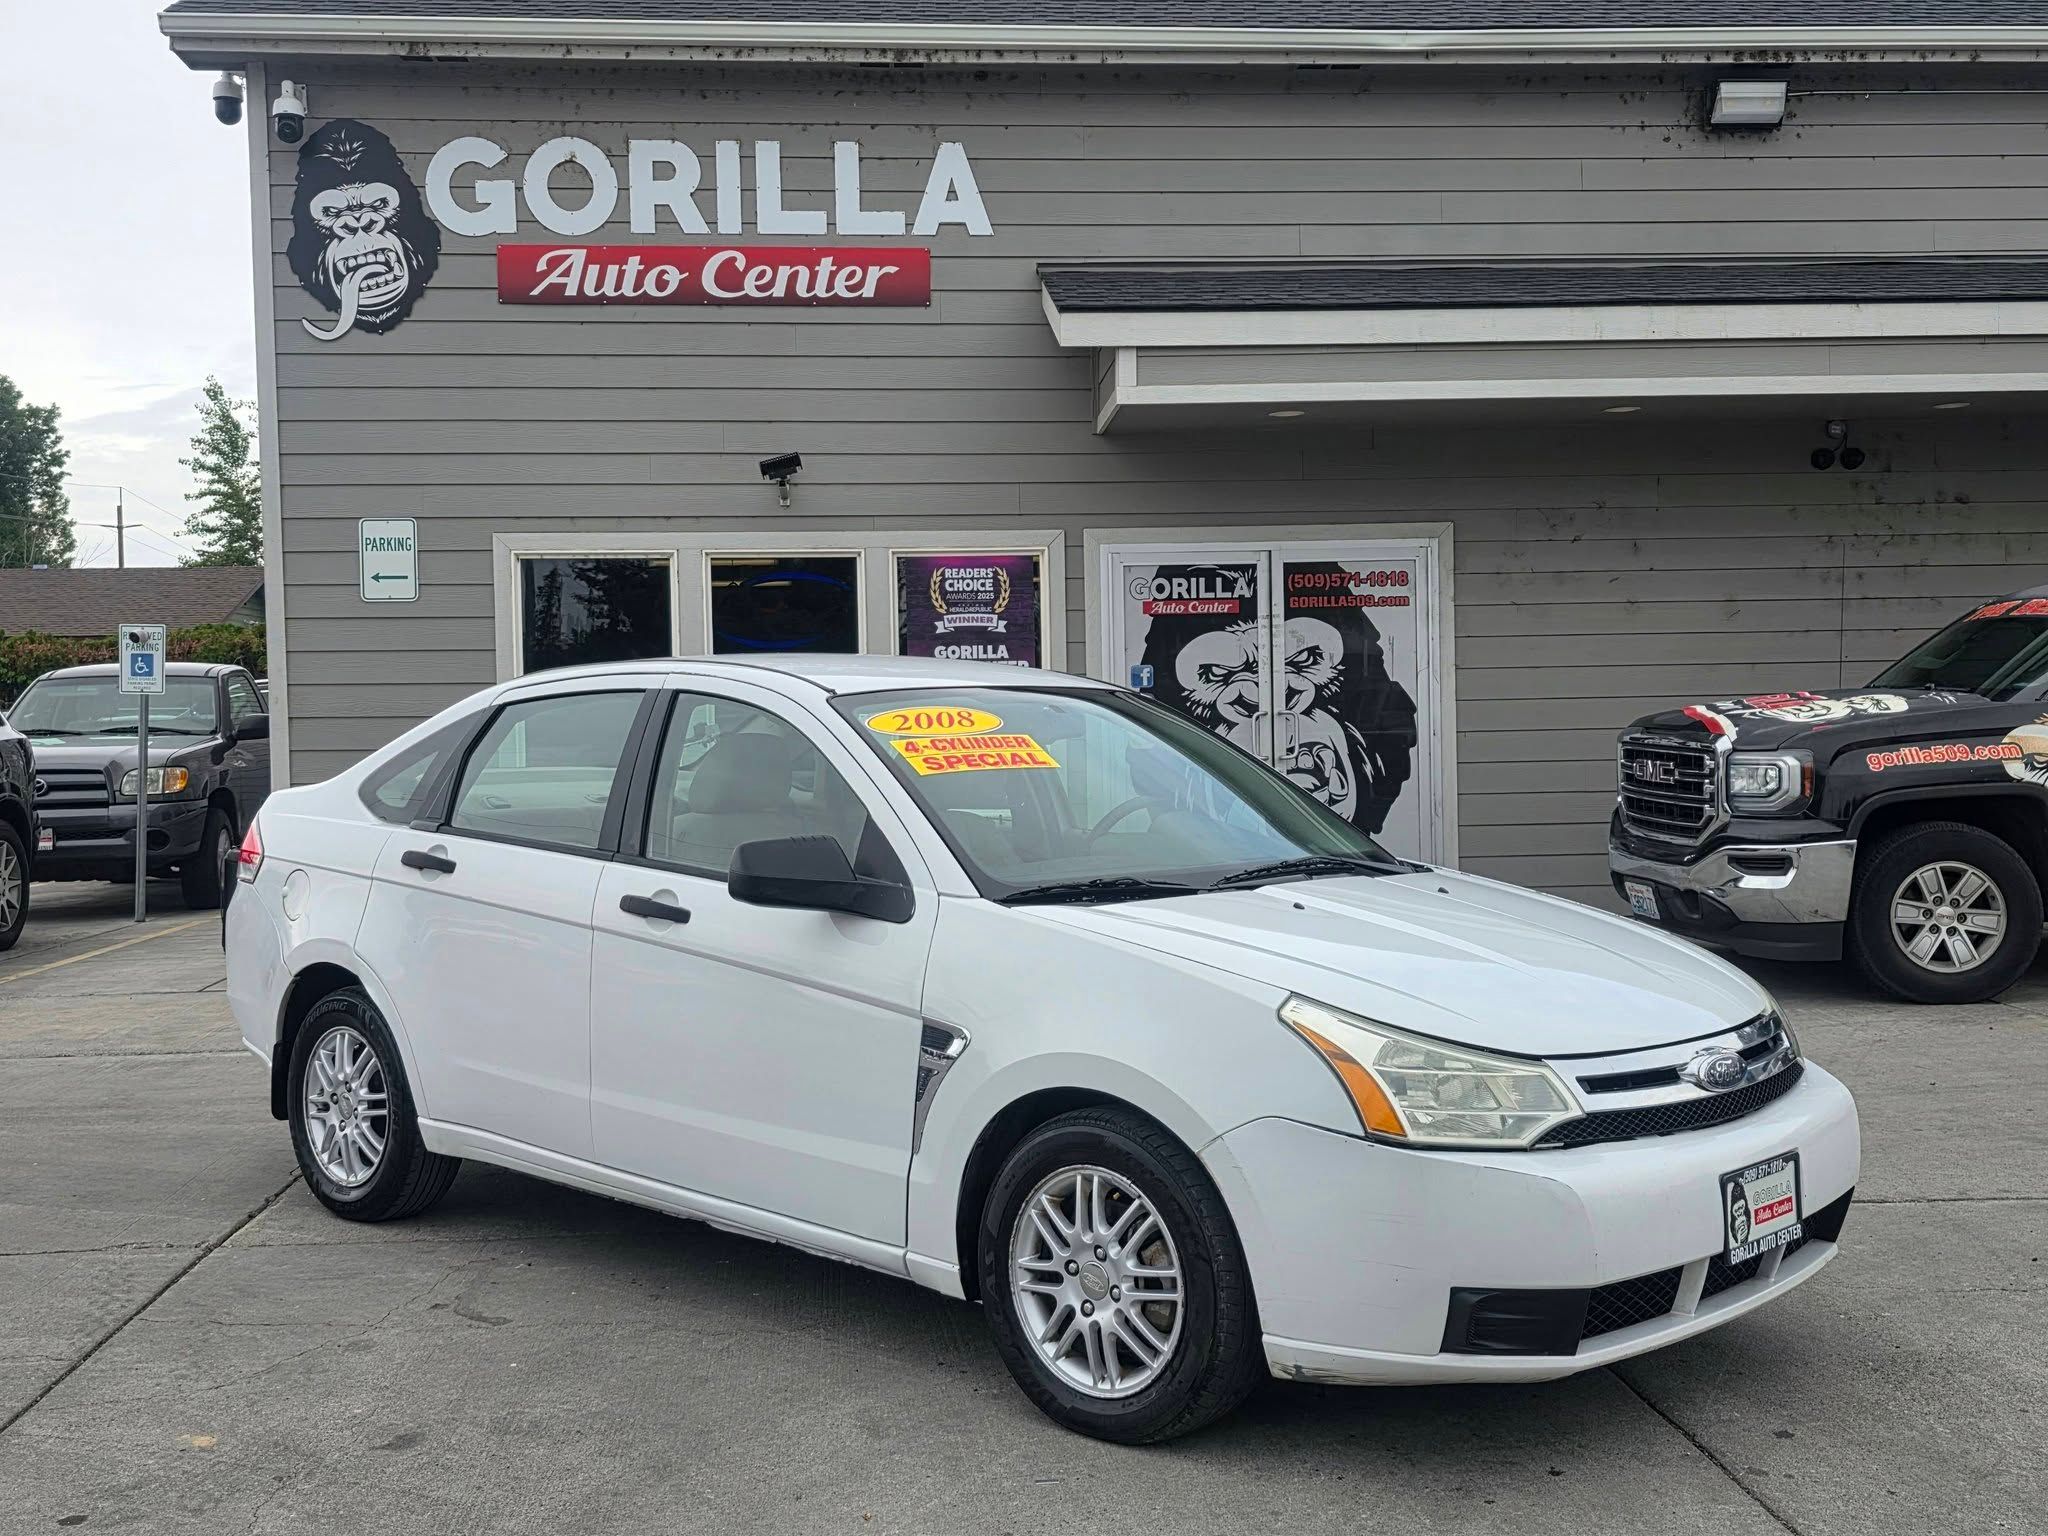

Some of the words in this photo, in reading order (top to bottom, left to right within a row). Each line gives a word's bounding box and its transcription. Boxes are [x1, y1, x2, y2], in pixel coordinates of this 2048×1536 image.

[425, 136, 994, 236] GORILLA
[528, 249, 688, 299] Auto
[702, 249, 902, 299] Center
[365, 537, 412, 552] PARKING
[945, 579, 994, 591] CHOICE
[1129, 577, 1251, 600] GORILLA
[1288, 571, 1409, 591] (509)571-1818
[1151, 601, 1185, 614] Auto
[1188, 601, 1233, 613] Center
[1289, 595, 1410, 608] GORILLA509.com
[946, 616, 994, 624] WINNER
[126, 643, 160, 652] PARKING
[934, 645, 1009, 659] GORILLA
[892, 711, 975, 731] 2008
[921, 752, 1048, 771] SPECIAL
[1866, 744, 2023, 772] gorilla509.com
[1634, 759, 1675, 785] GMC
[1753, 1180, 1793, 1206] GORILLA
[1756, 1208, 1772, 1222] Auto
[1773, 1200, 1792, 1216] Center
[1731, 1241, 1759, 1265] GORILLA
[1759, 1234, 1777, 1253] AUTO
[1777, 1224, 1802, 1245] CENTER
